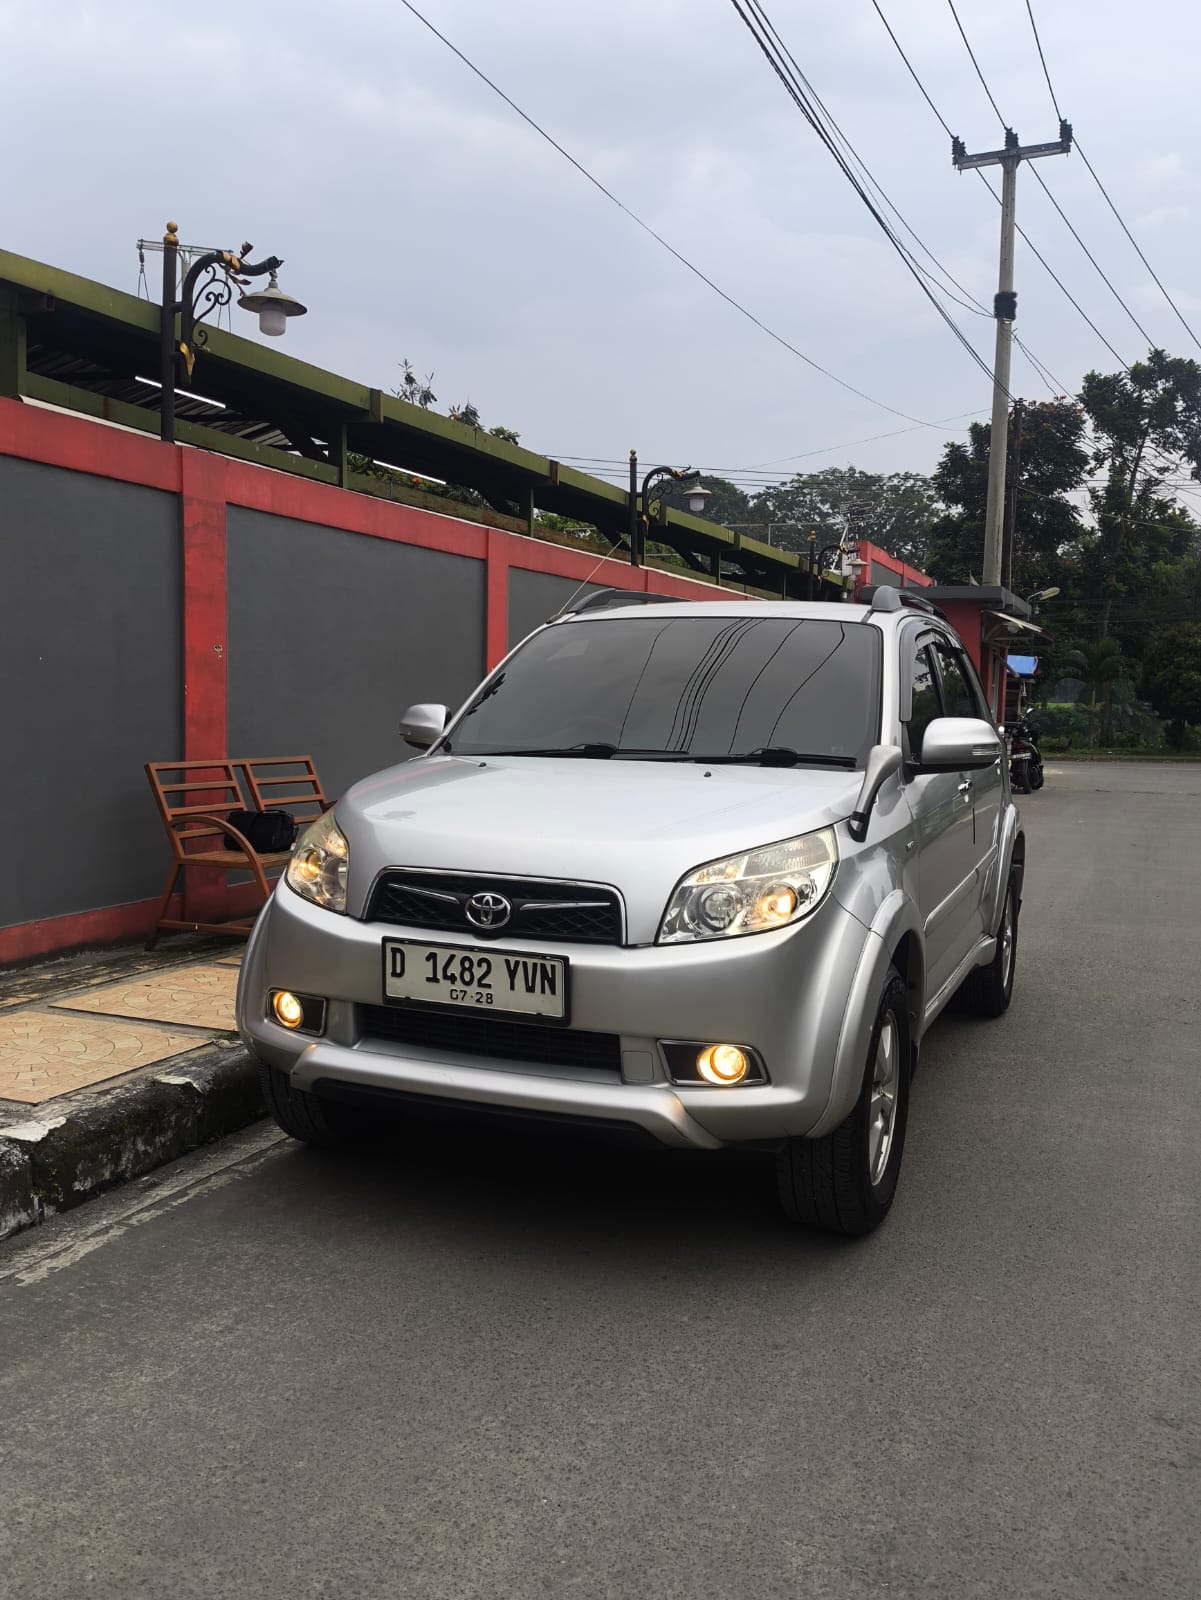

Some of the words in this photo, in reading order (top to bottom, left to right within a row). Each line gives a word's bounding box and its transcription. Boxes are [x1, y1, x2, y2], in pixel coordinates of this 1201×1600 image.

[390, 947, 406, 978] D
[425, 951, 492, 989] 1482
[504, 958, 556, 996] YVN
